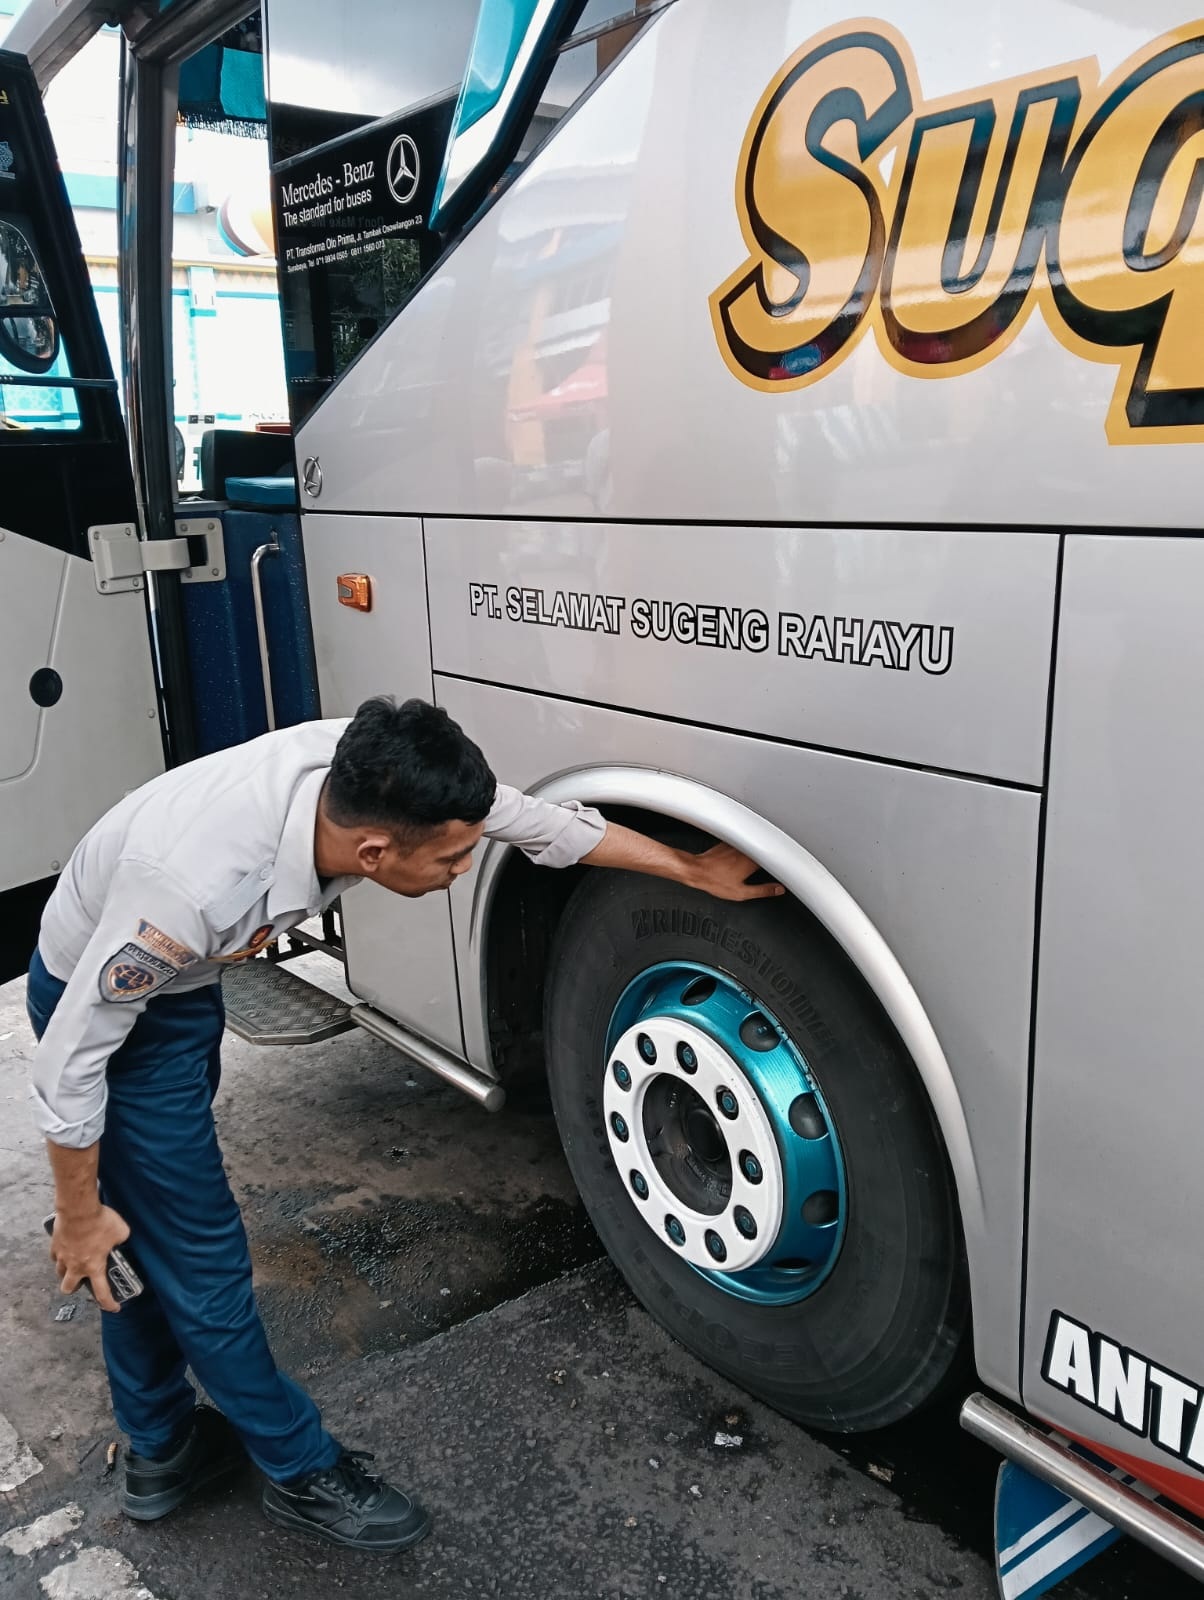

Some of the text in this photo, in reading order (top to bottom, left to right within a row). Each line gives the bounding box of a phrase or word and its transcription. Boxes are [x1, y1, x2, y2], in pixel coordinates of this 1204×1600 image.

[282, 173, 333, 208] Mercedes
[343, 161, 375, 187] Benz
[283, 189, 372, 228] The standard for buses
[415, 214, 423, 224] 23
[469, 583, 954, 676] PT. SELAMAT SUGENG RAHAYU
